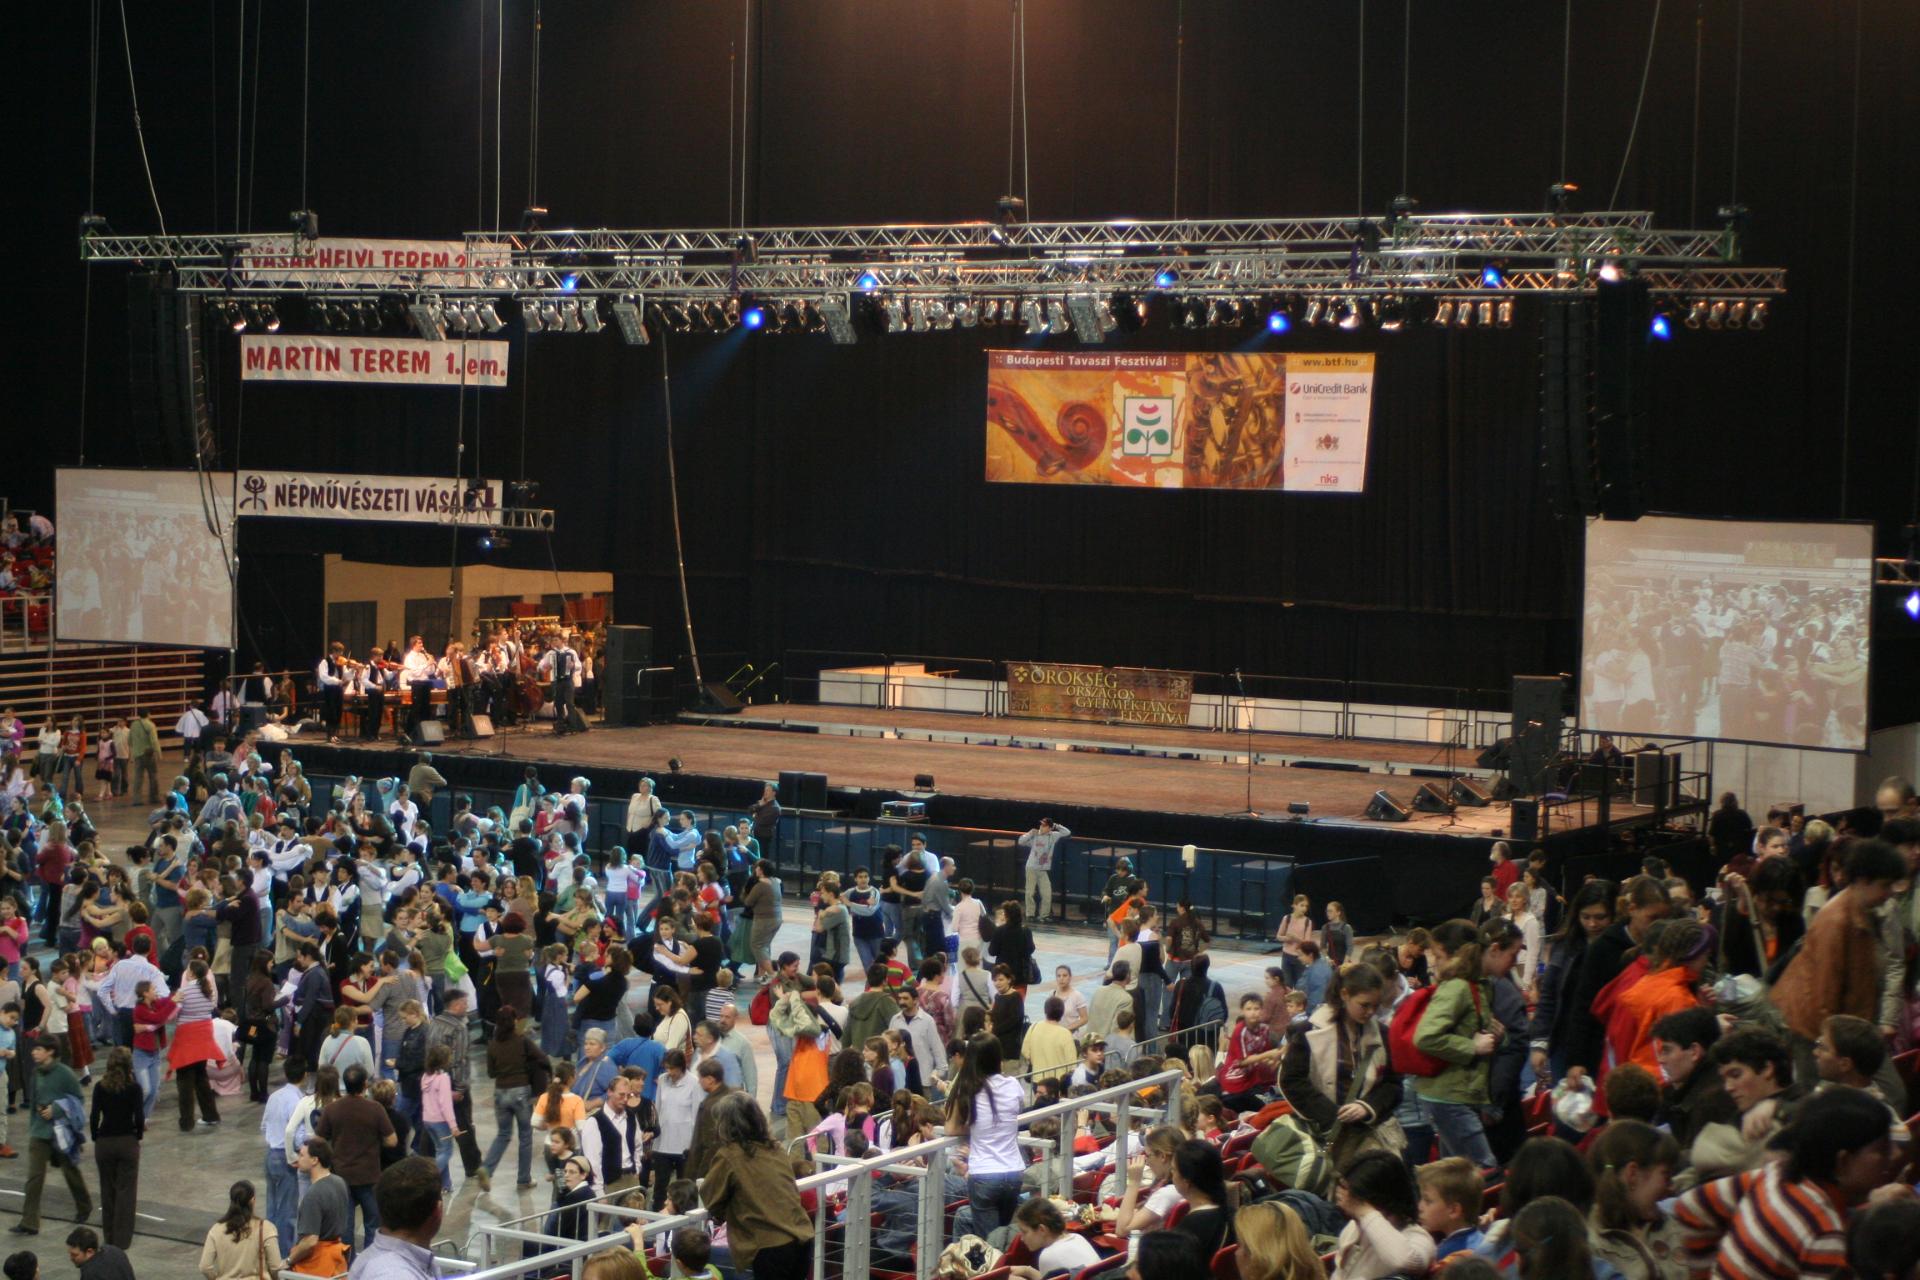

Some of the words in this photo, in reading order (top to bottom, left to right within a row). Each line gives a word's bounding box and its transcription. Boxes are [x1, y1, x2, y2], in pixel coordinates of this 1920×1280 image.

[382, 250, 449, 275] TEREM
[247, 347, 340, 372] MARTIN
[350, 348, 431, 374] TEREM
[446, 351, 461, 375] 1.
[466, 356, 506, 377] em.
[1006, 355, 1063, 367] Budapesti
[1068, 355, 1110, 366] Tavaszi
[1114, 356, 1167, 367] Fesztivál
[1303, 383, 1342, 394] UniCredit
[1344, 383, 1368, 394] Bank
[1320, 474, 1339, 484] nka
[274, 478, 409, 513] NÉPMŰVÉSZETI
[1030, 665, 1118, 689] ÖRÖKSÉG
